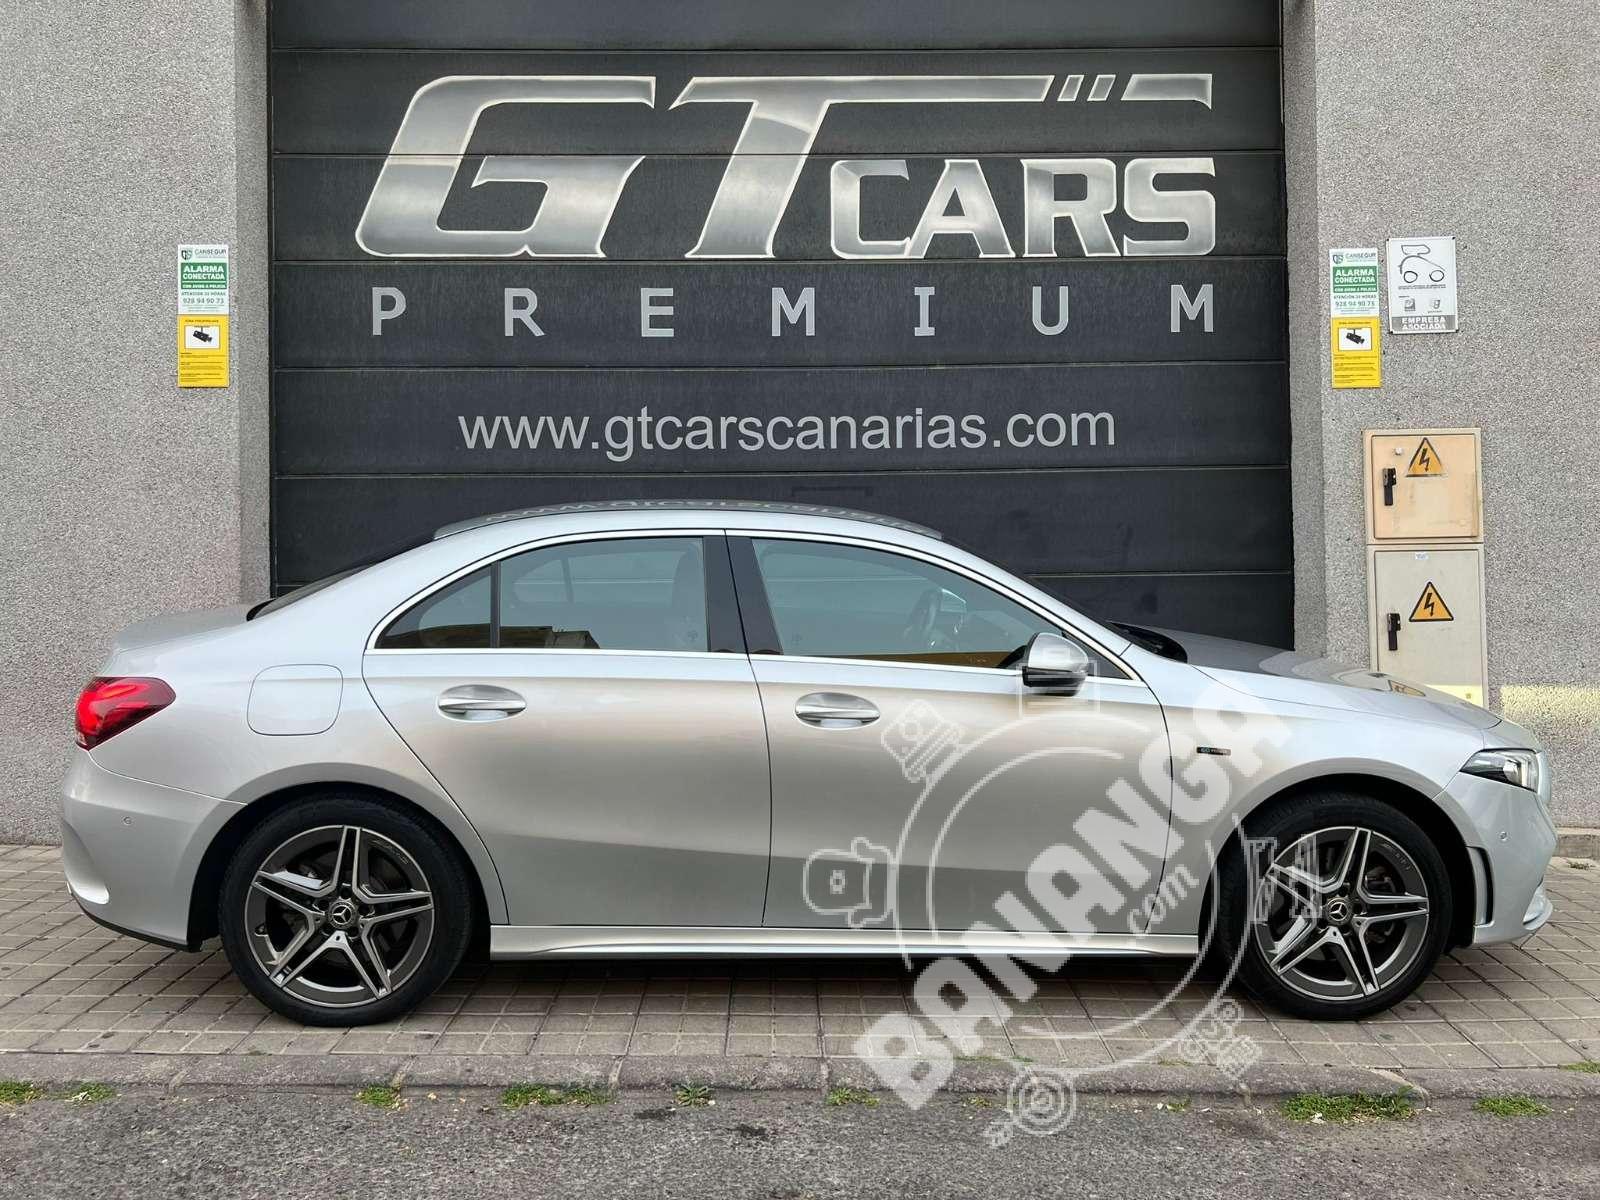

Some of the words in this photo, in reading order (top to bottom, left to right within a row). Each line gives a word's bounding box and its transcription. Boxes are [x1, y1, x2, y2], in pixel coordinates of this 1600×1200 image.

[183, 265, 225, 273] ALARMA
[1335, 268, 1374, 277] ALARMA
[1334, 276, 1376, 284] CONECTADA
[371, 283, 1214, 338] PREMIUM
[1401, 316, 1446, 324] EMPRESA
[457, 405, 1116, 463] www.gtcarscanarias.com
